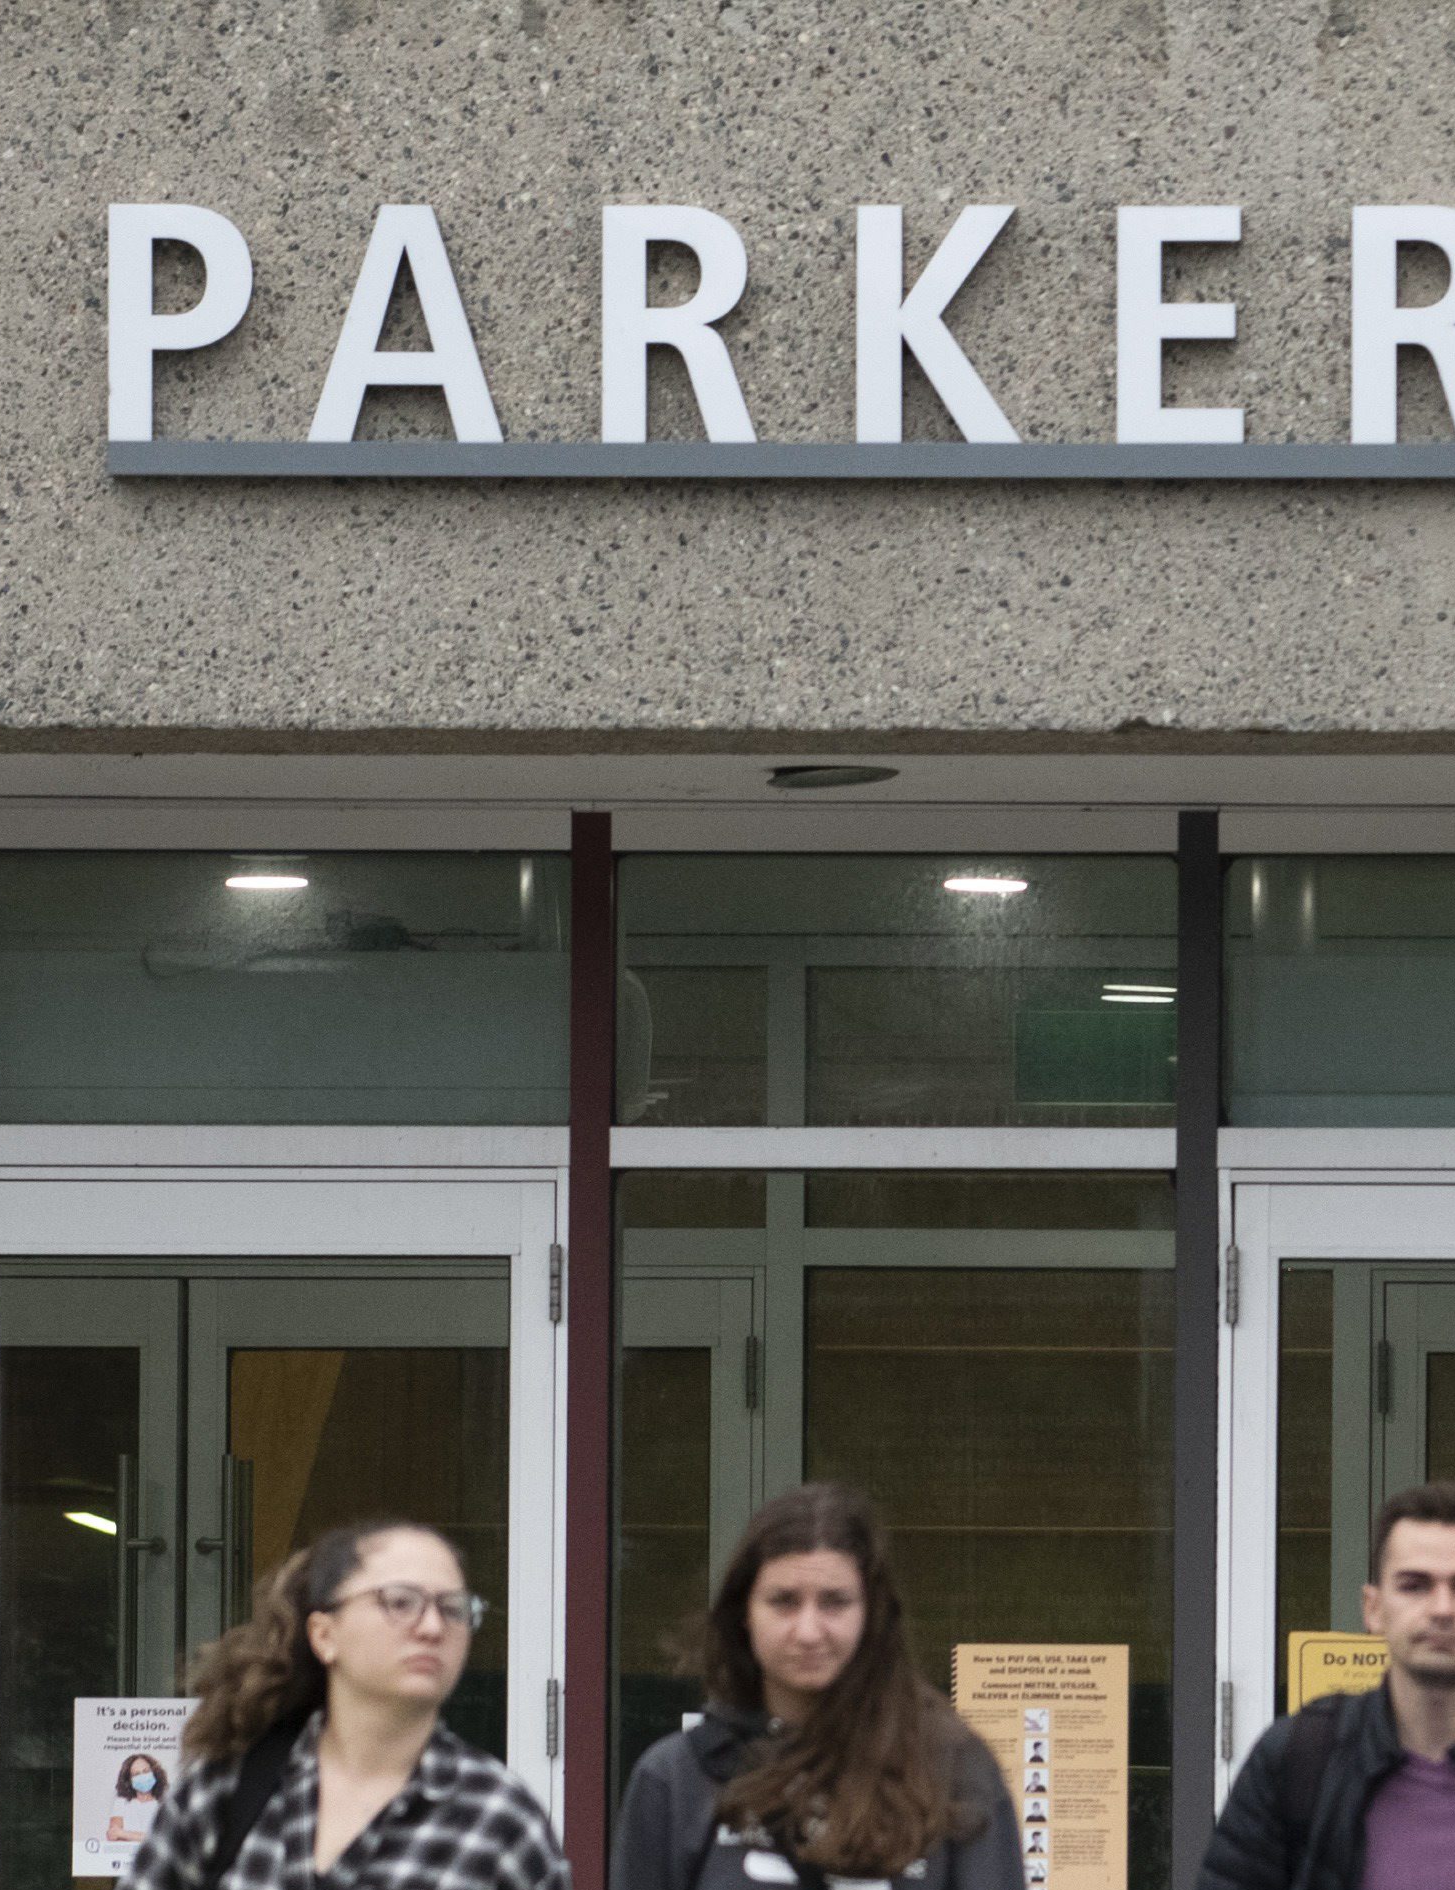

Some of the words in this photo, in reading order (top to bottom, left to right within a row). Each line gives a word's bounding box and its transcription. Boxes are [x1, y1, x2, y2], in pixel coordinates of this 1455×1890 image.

[973, 1655, 993, 1663] How
[1007, 1655, 1024, 1663] PUT
[1066, 1655, 1088, 1663] TAKE
[1090, 1655, 1107, 1664] OFF
[1323, 1652, 1347, 1666] Do
[1352, 1652, 1388, 1666] NOT
[972, 1692, 1008, 1700] ENLEVER
[119, 1708, 127, 1716] a
[130, 1706, 187, 1719] personal
[113, 1720, 170, 1731] decision.
